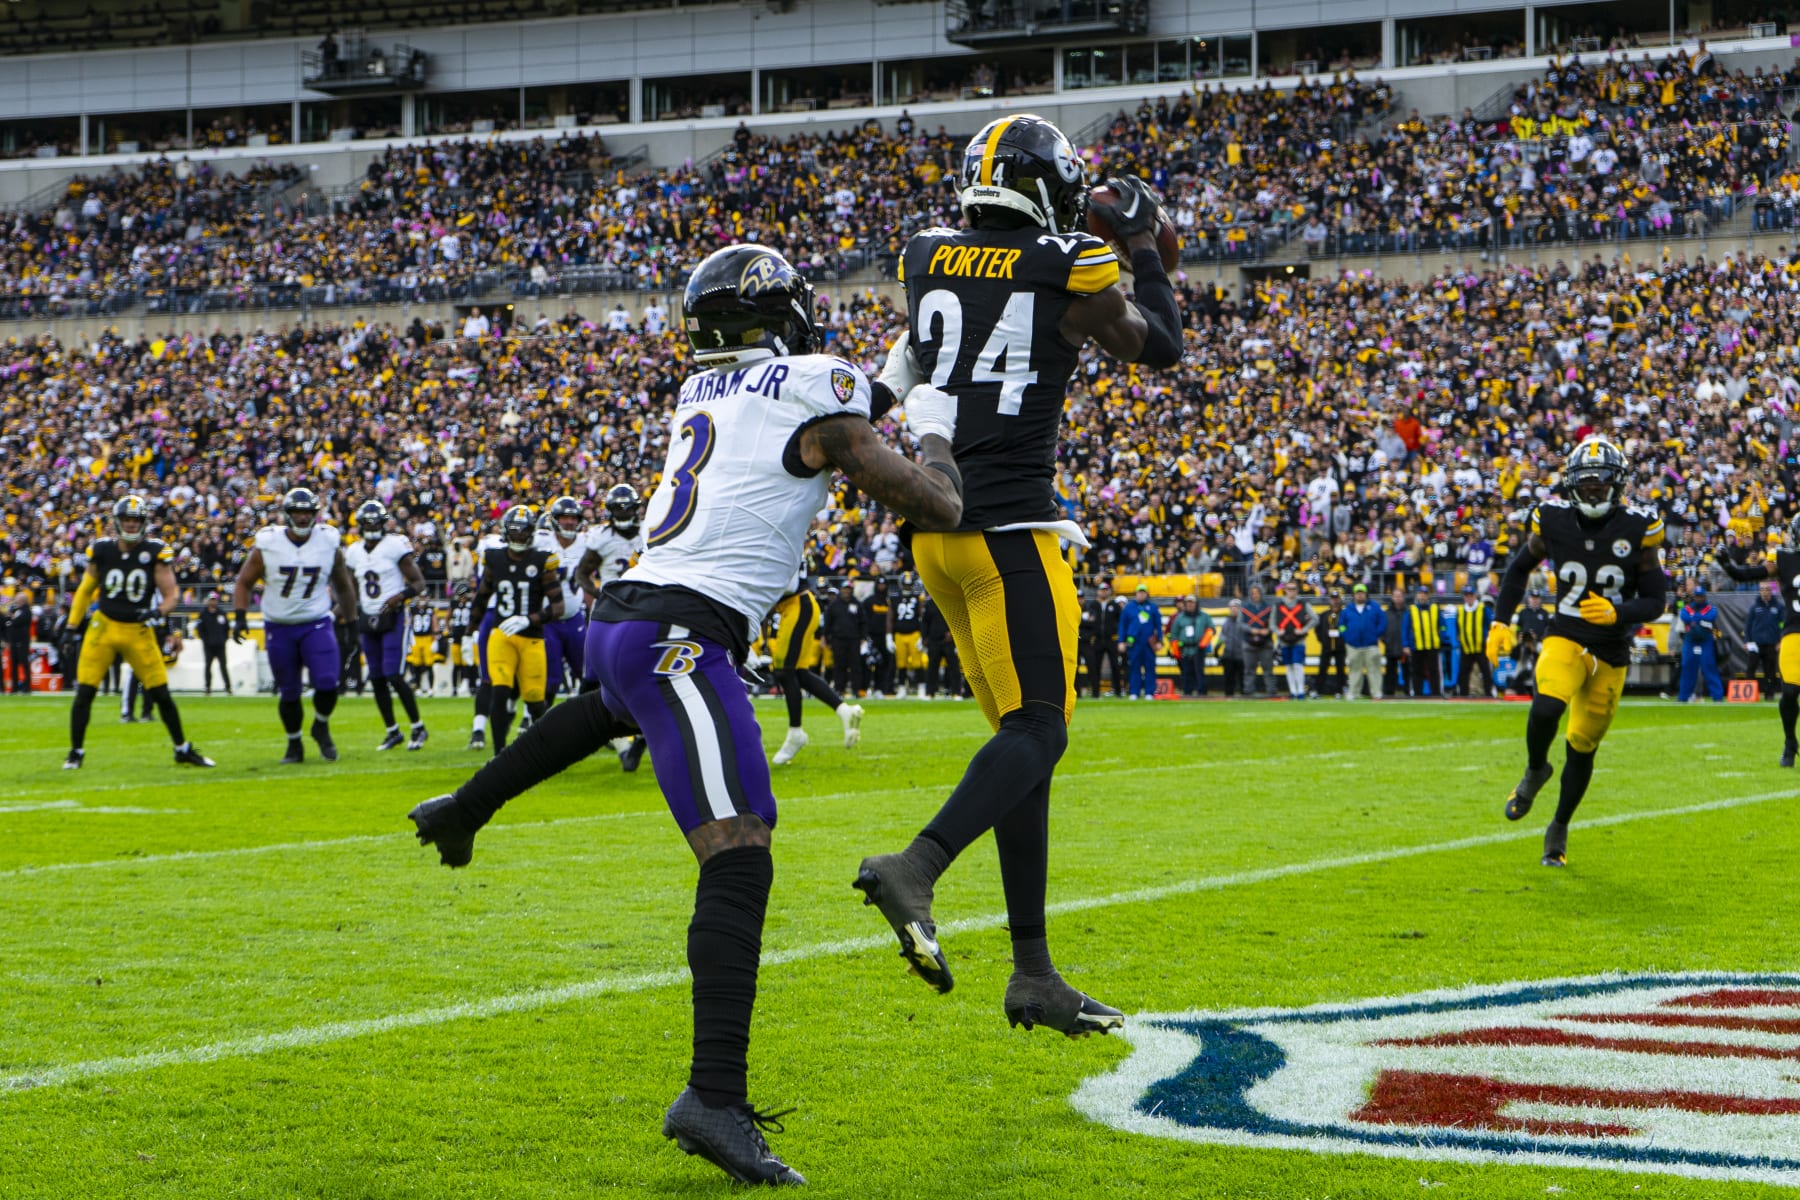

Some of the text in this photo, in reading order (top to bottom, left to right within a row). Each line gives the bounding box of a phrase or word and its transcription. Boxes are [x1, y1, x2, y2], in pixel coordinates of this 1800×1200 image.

[971, 161, 1004, 187] 24
[972, 188, 1001, 199] Steelers
[928, 244, 1022, 280] PORTER
[712, 329, 725, 347] 3
[917, 289, 1039, 416] 24
[745, 364, 790, 401] JR
[646, 410, 717, 550] 3
[104, 568, 148, 603] 90
[278, 565, 322, 600] 77
[364, 569, 382, 599] 8
[498, 580, 531, 618] 31
[1558, 561, 1626, 618] 23
[897, 602, 915, 620] 95
[648, 640, 704, 676] B
[1732, 684, 1754, 699] 10
